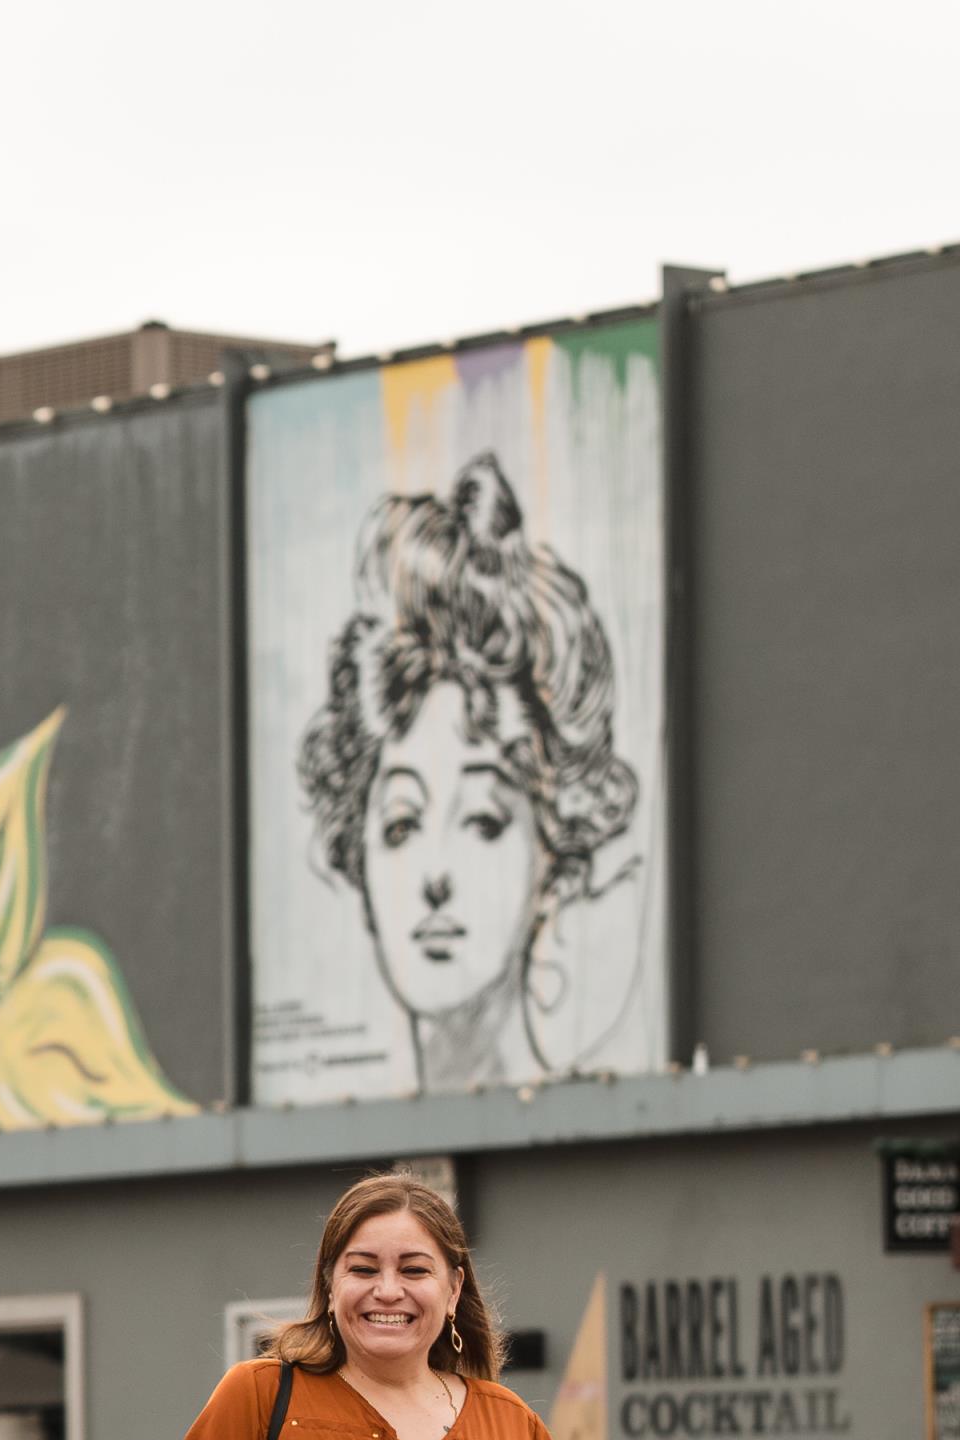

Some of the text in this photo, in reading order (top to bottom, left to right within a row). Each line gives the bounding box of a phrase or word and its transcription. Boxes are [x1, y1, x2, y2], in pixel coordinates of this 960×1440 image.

[619, 1272, 847, 1383] BARREL AGED
[620, 1389, 850, 1439] COCKTAIL
